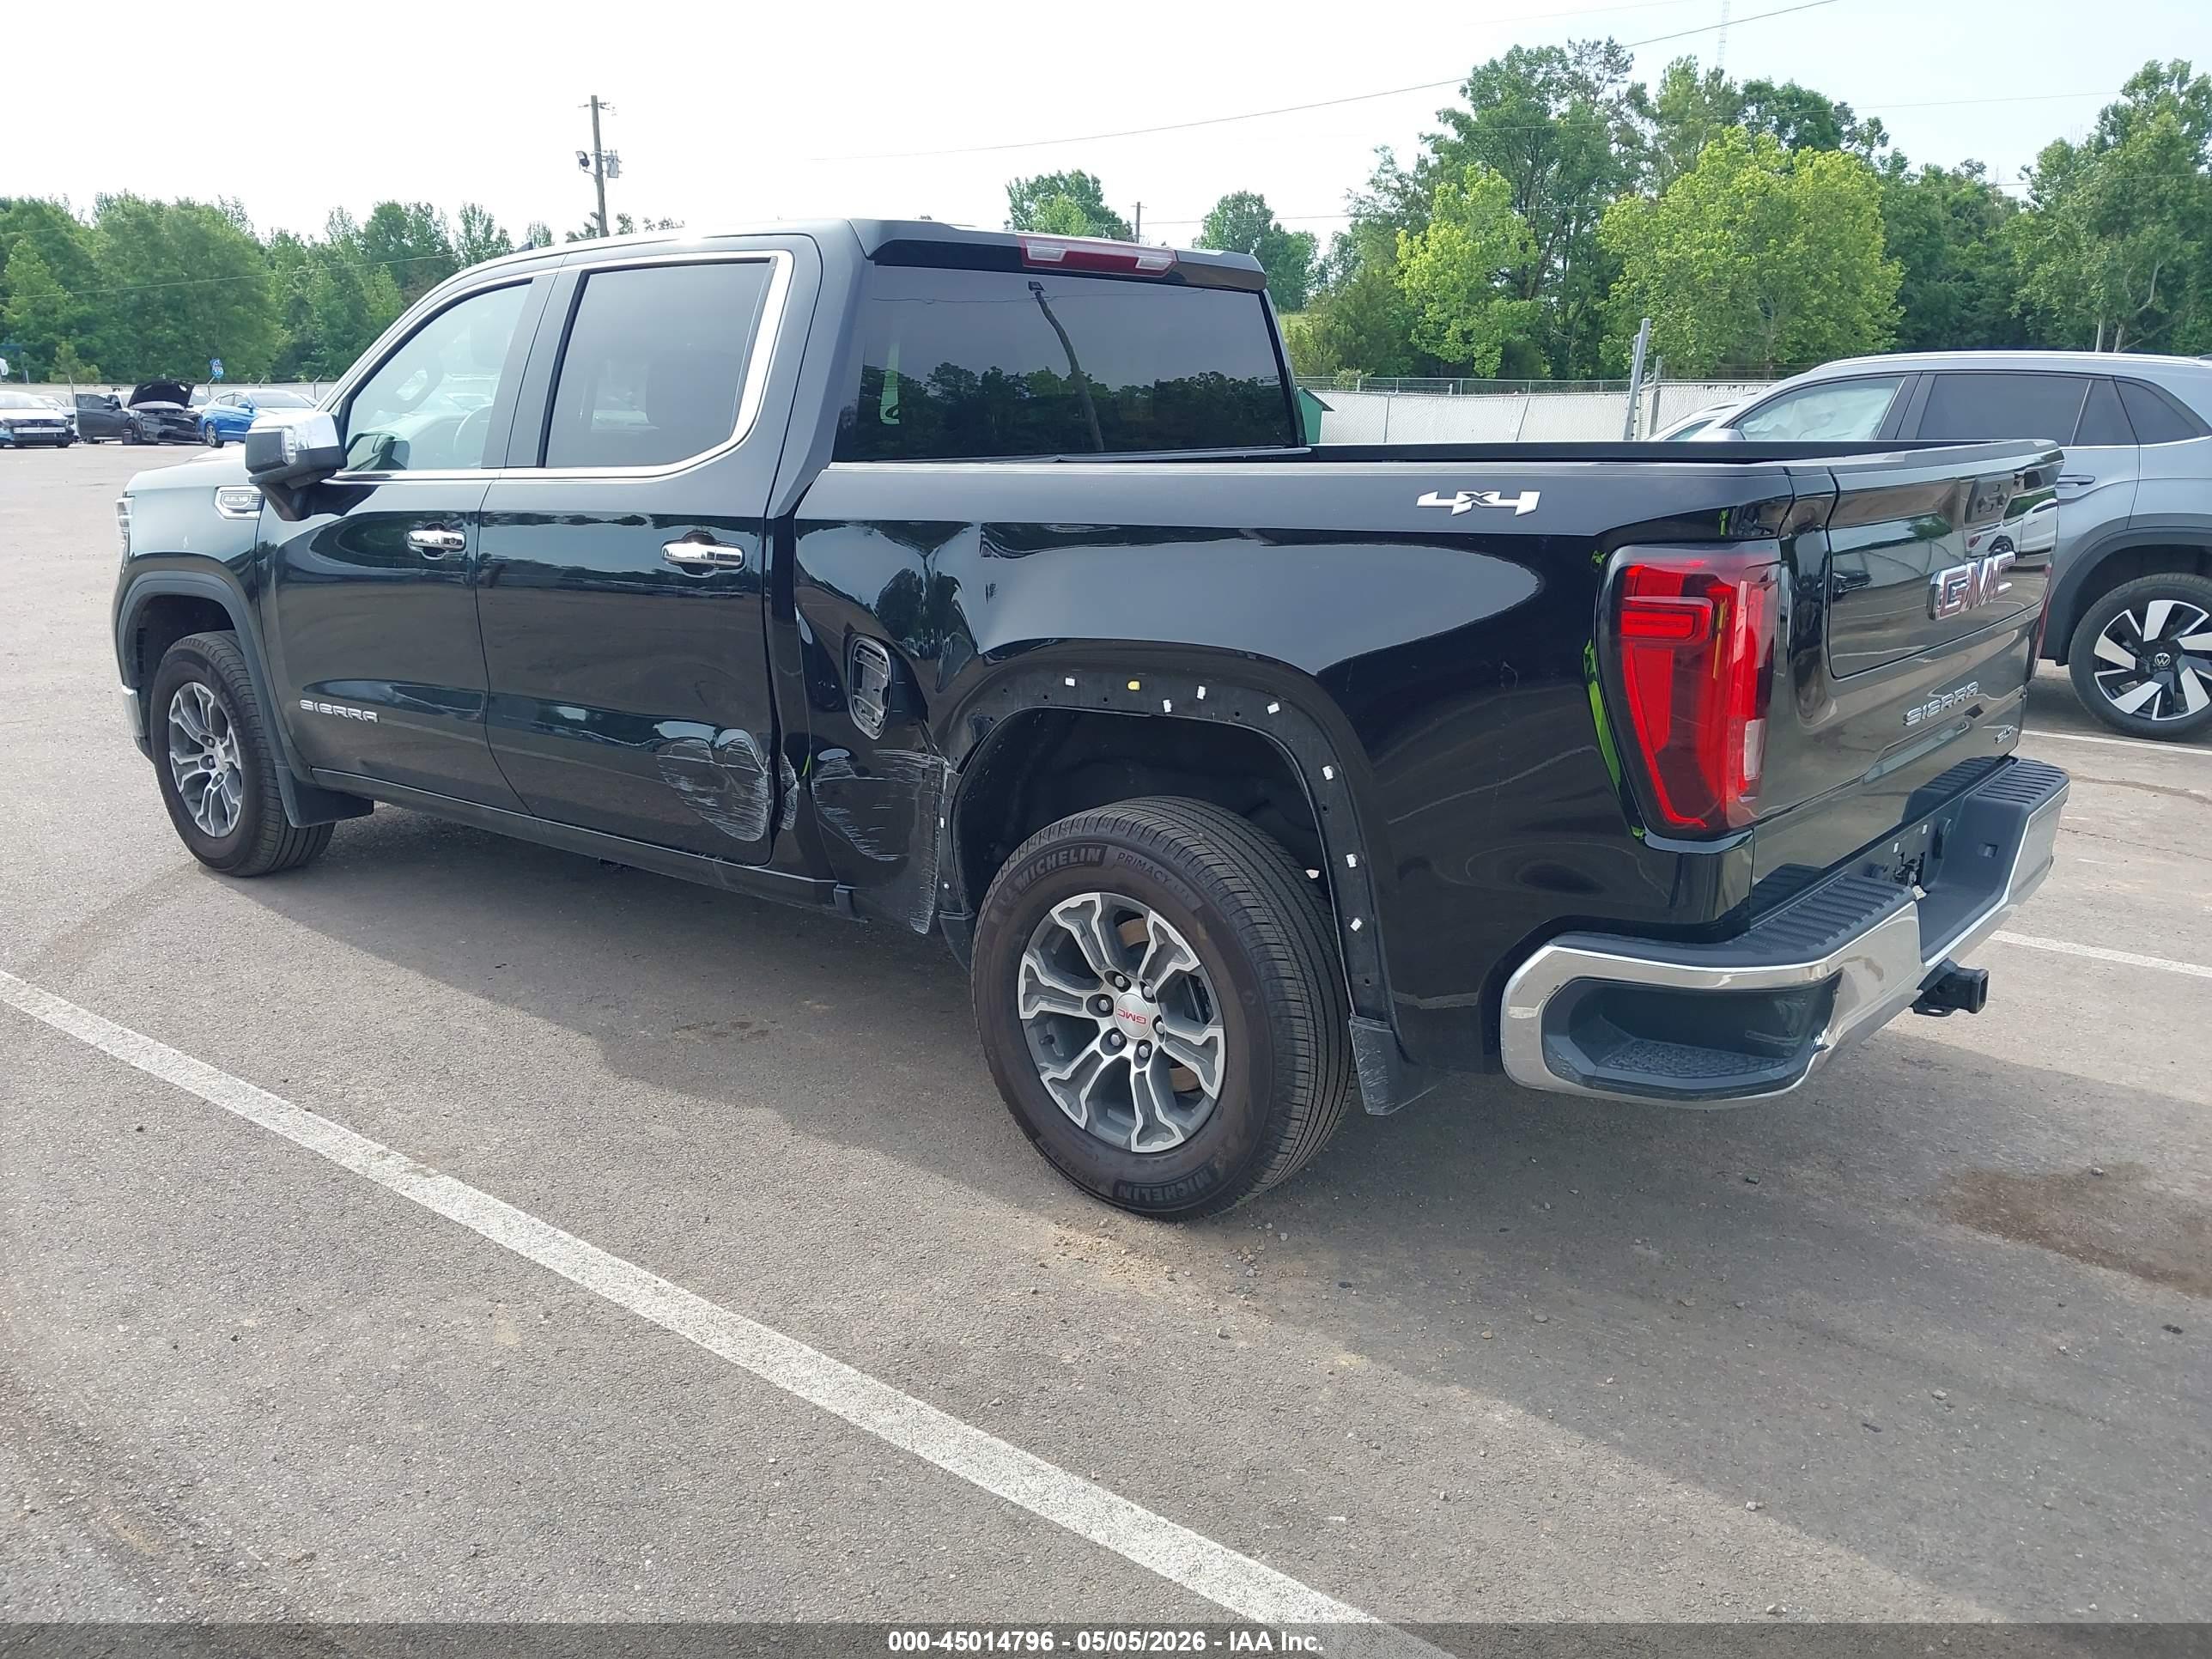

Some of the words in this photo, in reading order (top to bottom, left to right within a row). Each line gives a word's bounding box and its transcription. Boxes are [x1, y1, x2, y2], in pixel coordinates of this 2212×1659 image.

[1930, 550, 2016, 620] GMC
[300, 699, 379, 723] SIERRA
[1904, 681, 1979, 726] SIERRA
[1015, 847, 1103, 890] MICHELIN
[1116, 851, 1172, 884] PRIMACY
[1116, 1008, 1147, 1025] GMC
[1118, 1164, 1216, 1201] MICHELIN
